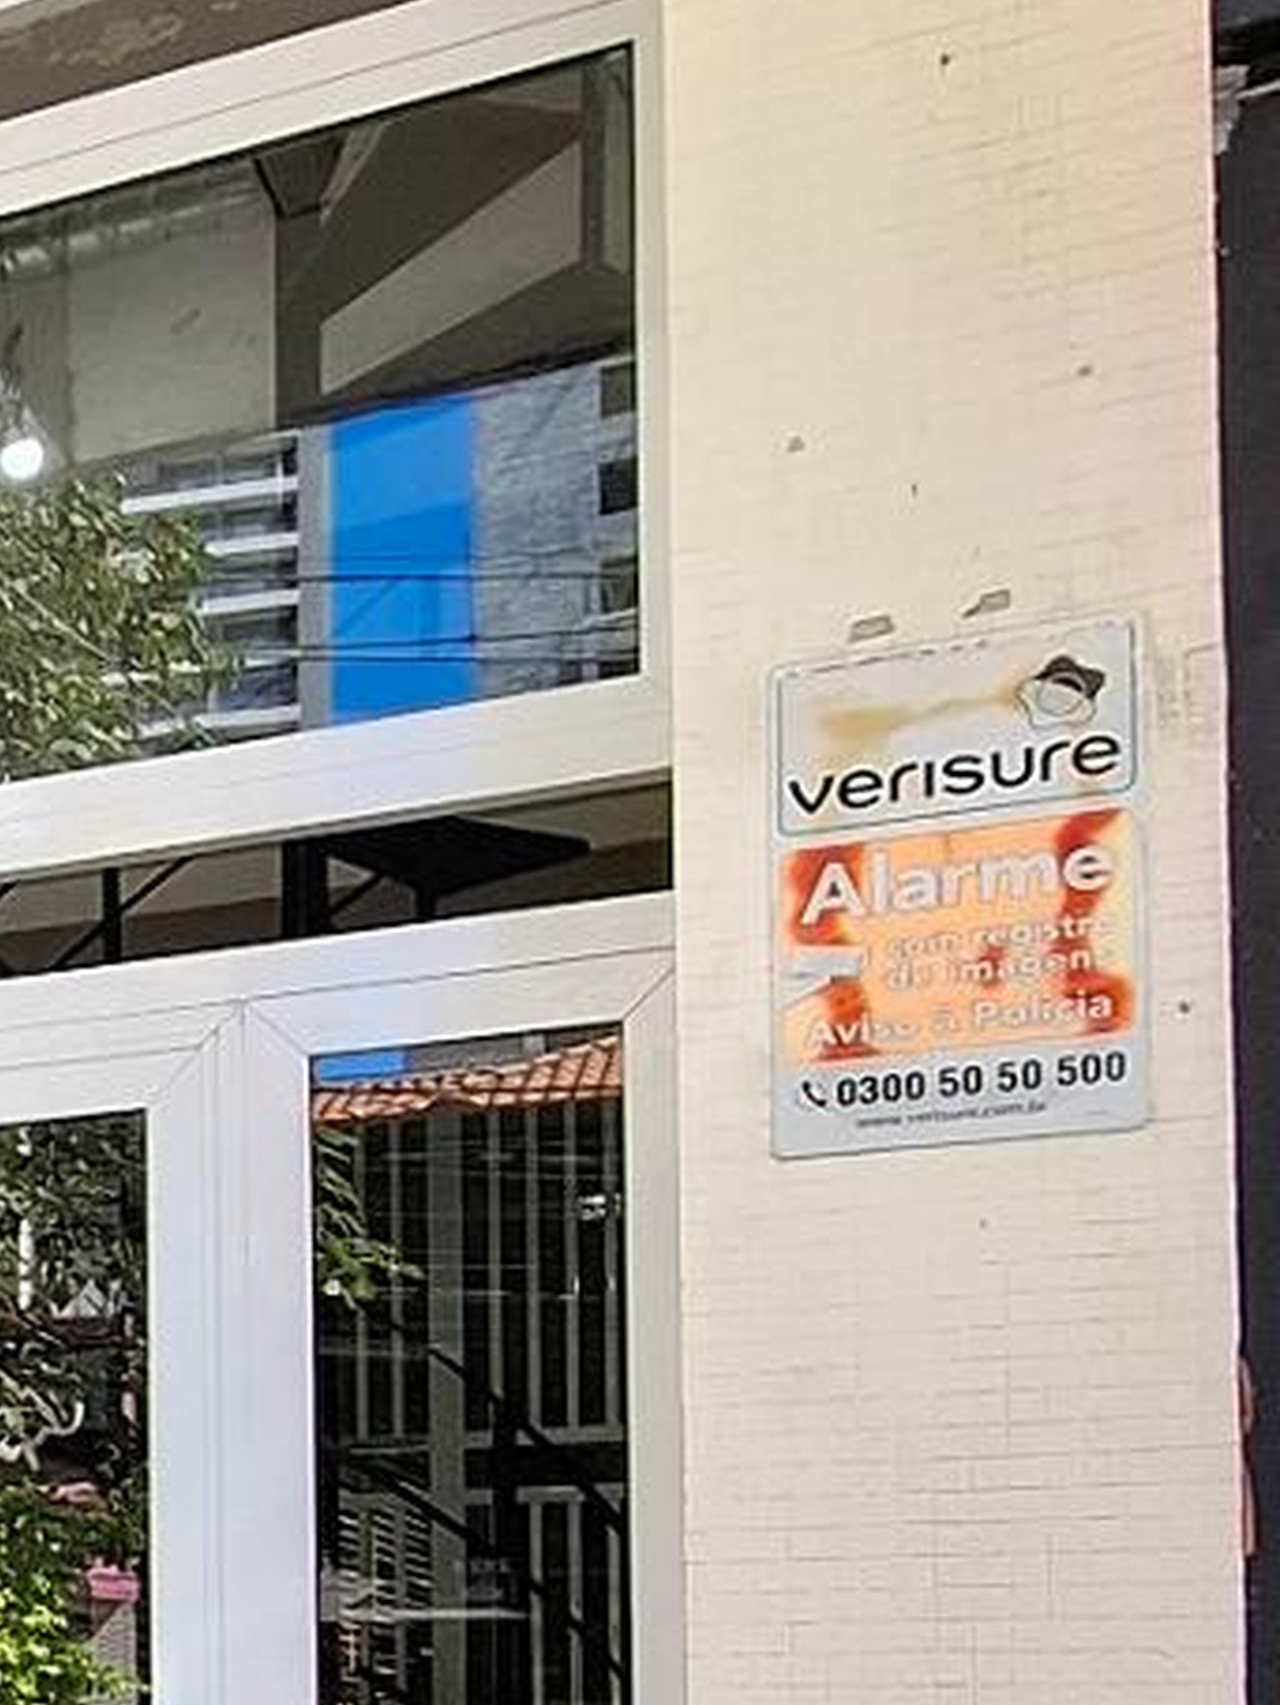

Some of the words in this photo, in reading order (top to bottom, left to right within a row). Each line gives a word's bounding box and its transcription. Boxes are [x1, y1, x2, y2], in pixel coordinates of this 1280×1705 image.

[788, 733, 1120, 814] verisure
[800, 841, 1115, 925] Alarme
[836, 1071, 926, 1107] 0300
[938, 1064, 983, 1098] 50
[997, 1059, 1042, 1093] 50
[1056, 1050, 1127, 1087] 500
